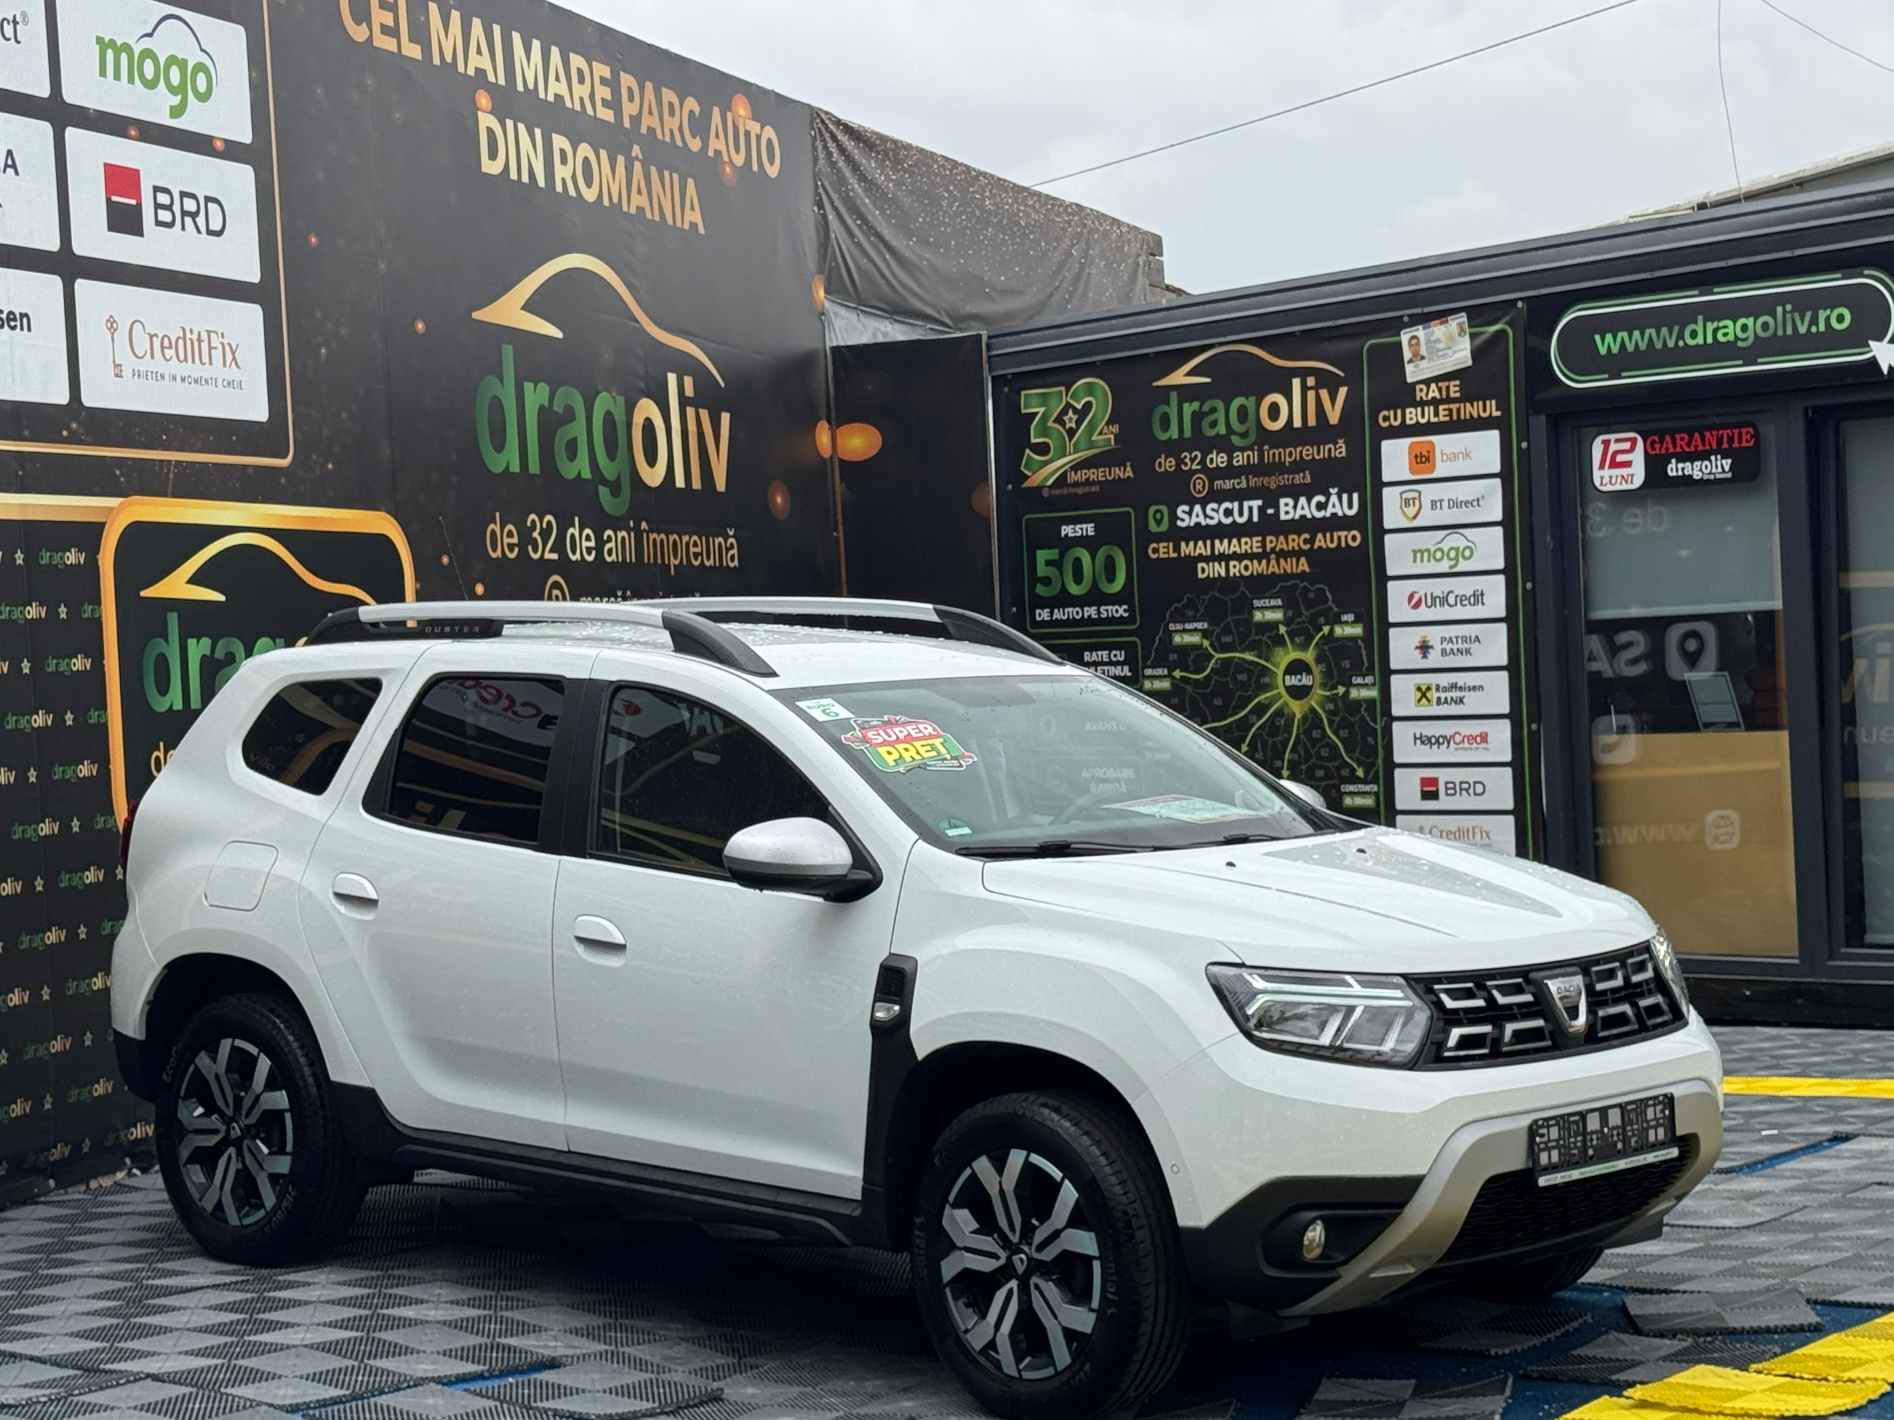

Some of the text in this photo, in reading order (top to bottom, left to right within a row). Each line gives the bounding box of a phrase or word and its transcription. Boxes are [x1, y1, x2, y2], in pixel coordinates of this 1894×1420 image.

[95, 35, 214, 120] mogo
[338, 0, 781, 179] CEL MAI MARE PARC AUTO
[477, 111, 706, 235] DIN ROMÂNIA
[152, 185, 227, 238] BRD
[1594, 303, 1852, 356] www.dragoliv.ro
[128, 319, 242, 370] CreditFix
[132, 368, 244, 390] PRIETEN IN MOMENTE CHEIE
[1415, 380, 1461, 401] RATE
[1152, 376, 1348, 446] dragoliv
[1378, 399, 1502, 428] CU BULETINUL
[476, 343, 731, 517] dragoliv
[1102, 423, 1119, 435] ANI
[1155, 438, 1347, 473] de 32 de ani împreună
[1413, 446, 1473, 465] tbi bank
[1598, 427, 1755, 471] 12 GARANTIE
[1066, 462, 1134, 484] ÎMPREUNĂ
[1667, 454, 1732, 480] dragoliv
[1213, 475, 1247, 491] marcă
[1248, 470, 1311, 489] înregistrată
[1599, 473, 1636, 487] LUNI
[1175, 499, 1263, 528] SASCUT
[1279, 488, 1360, 521] BACĂU
[1403, 496, 1418, 509] BT
[1430, 499, 1445, 511] BT
[1060, 523, 1096, 538] PESTE
[486, 511, 739, 576] de 32 de ani împreună
[1147, 529, 1362, 560] CEL MAI MARE PARC AUTO
[39, 547, 86, 568] dragoliv
[1197, 554, 1310, 580] DIN ROMÂNIA
[1411, 544, 1475, 570] mogo
[1034, 544, 1127, 597] 500
[1424, 589, 1486, 609] UniCredit
[1035, 604, 1130, 622] DE AUTO PE STOC
[425, 625, 480, 634] DUSTER
[1440, 634, 1482, 646] PATRIA
[1083, 649, 1125, 663] RATE CU
[1440, 647, 1473, 658] BANK
[45, 653, 92, 676] dragoliv
[1284, 671, 1314, 687] BACĂU
[1435, 682, 1484, 693] Raiffeisen
[805, 702, 836, 710] EURO
[1435, 696, 1466, 706] BANK
[4, 709, 54, 733] dragoliv
[821, 707, 840, 718] 6
[866, 723, 938, 744] SUPER
[1413, 731, 1489, 750] HappyCredit
[876, 737, 952, 767] PREȚ
[51, 759, 98, 783] dragoliv
[1444, 781, 1486, 797] BRD
[11, 817, 60, 842] dragoliv
[1428, 824, 1493, 841] CreditFix
[58, 865, 105, 890] dragoliv
[18, 926, 67, 950] dragoliv
